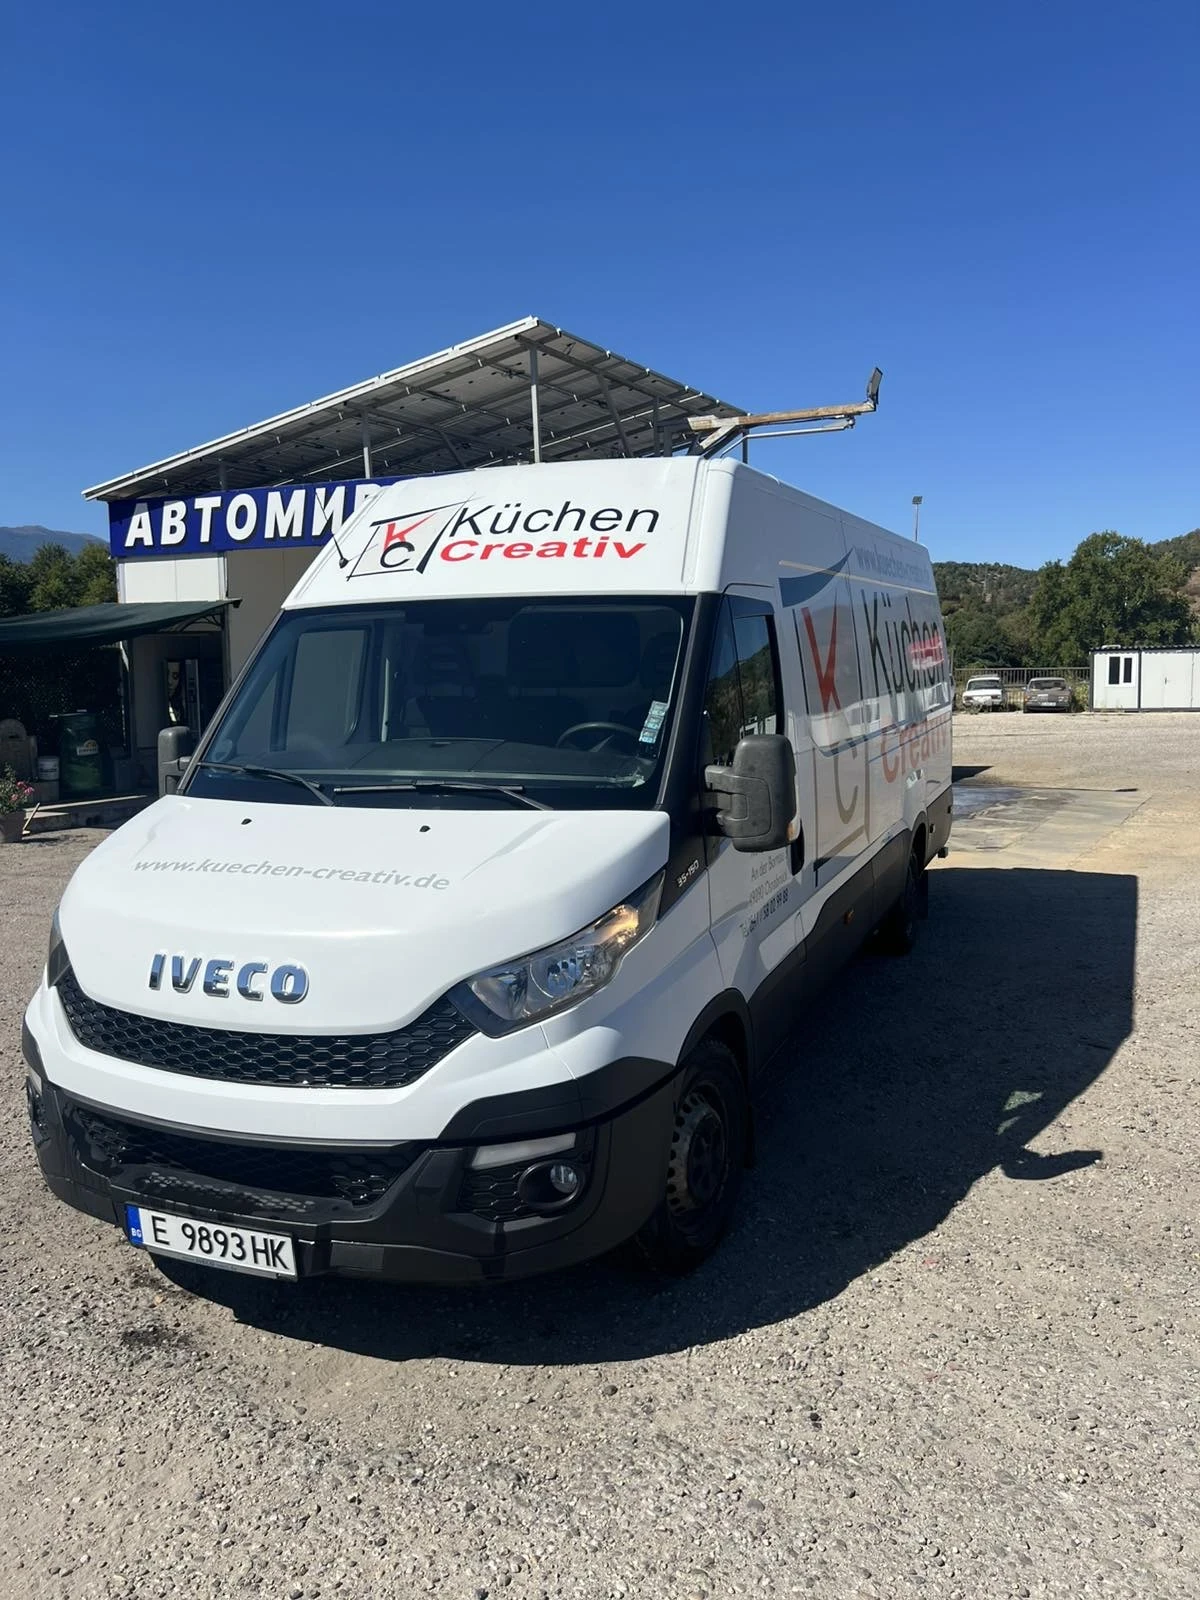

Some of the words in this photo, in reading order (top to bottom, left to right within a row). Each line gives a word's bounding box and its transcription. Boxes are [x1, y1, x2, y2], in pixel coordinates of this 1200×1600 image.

[449, 500, 660, 538] Küchen
[440, 536, 647, 562] Creativ
[861, 588, 946, 697] Küchen
[134, 858, 450, 890] www.kuechen-creativ.de
[149, 951, 310, 1004] IVECO
[131, 1227, 142, 1238] BG
[151, 1215, 170, 1246] E
[181, 1222, 247, 1261] 9893
[250, 1235, 289, 1270] HK
